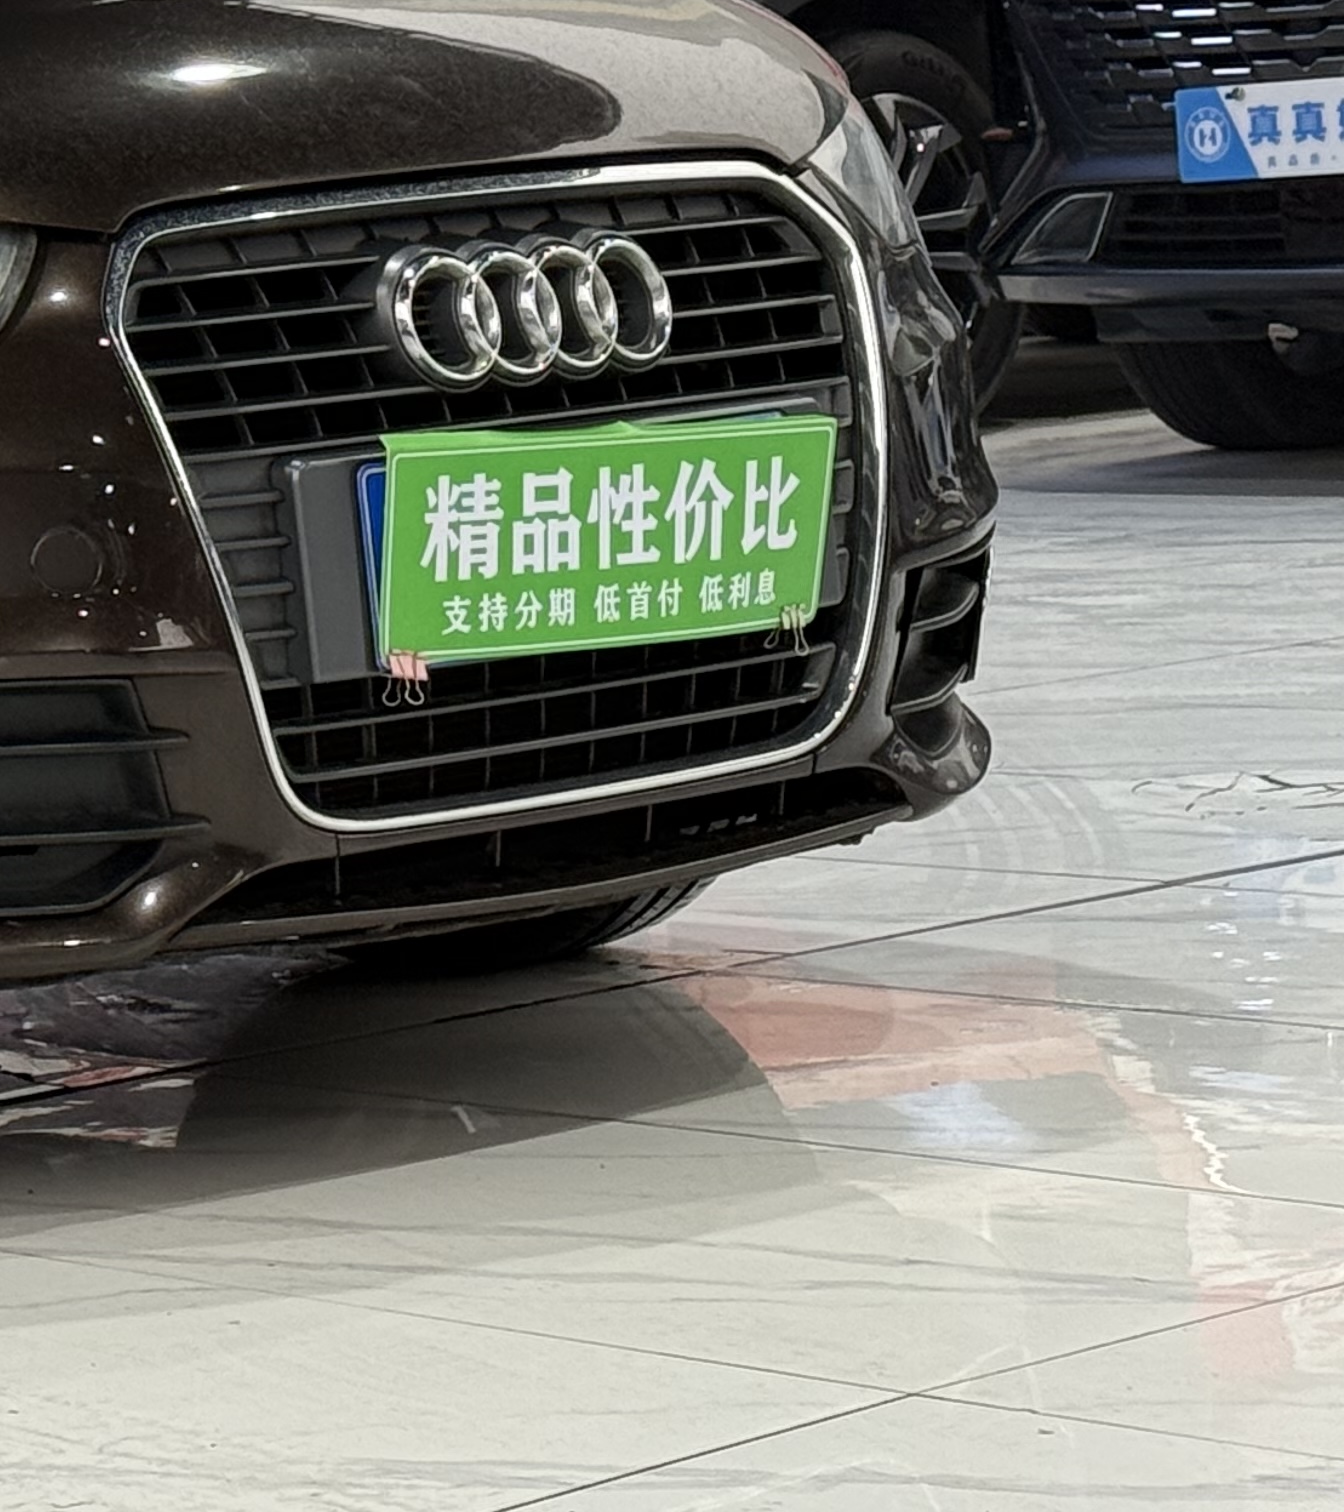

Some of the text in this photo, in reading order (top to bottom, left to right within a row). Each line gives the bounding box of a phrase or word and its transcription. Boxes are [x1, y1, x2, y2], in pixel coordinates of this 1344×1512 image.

[1247, 98, 1344, 147] 真真
[419, 455, 801, 583] 精品性价比
[441, 567, 777, 636] 支持分期 低首付 低利息
